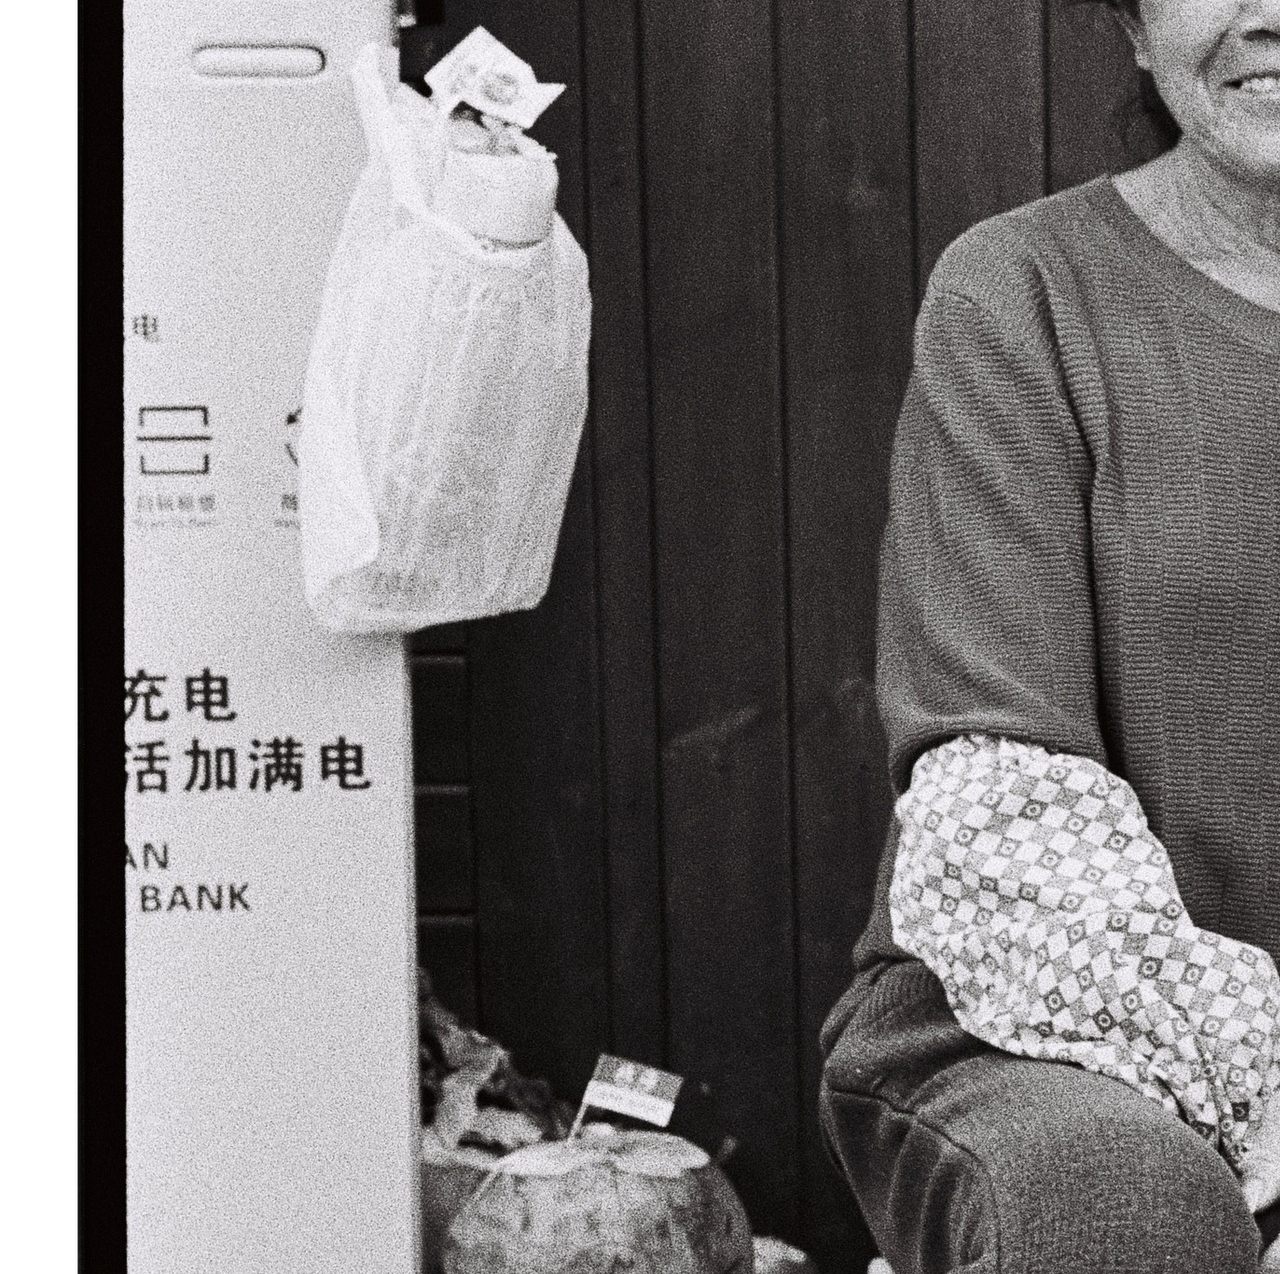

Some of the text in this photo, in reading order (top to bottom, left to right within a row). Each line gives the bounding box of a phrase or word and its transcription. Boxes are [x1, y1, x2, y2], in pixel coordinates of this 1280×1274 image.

[124, 668, 237, 721] 充电
[124, 736, 371, 793] 活加满电
[140, 883, 251, 912] BANK
